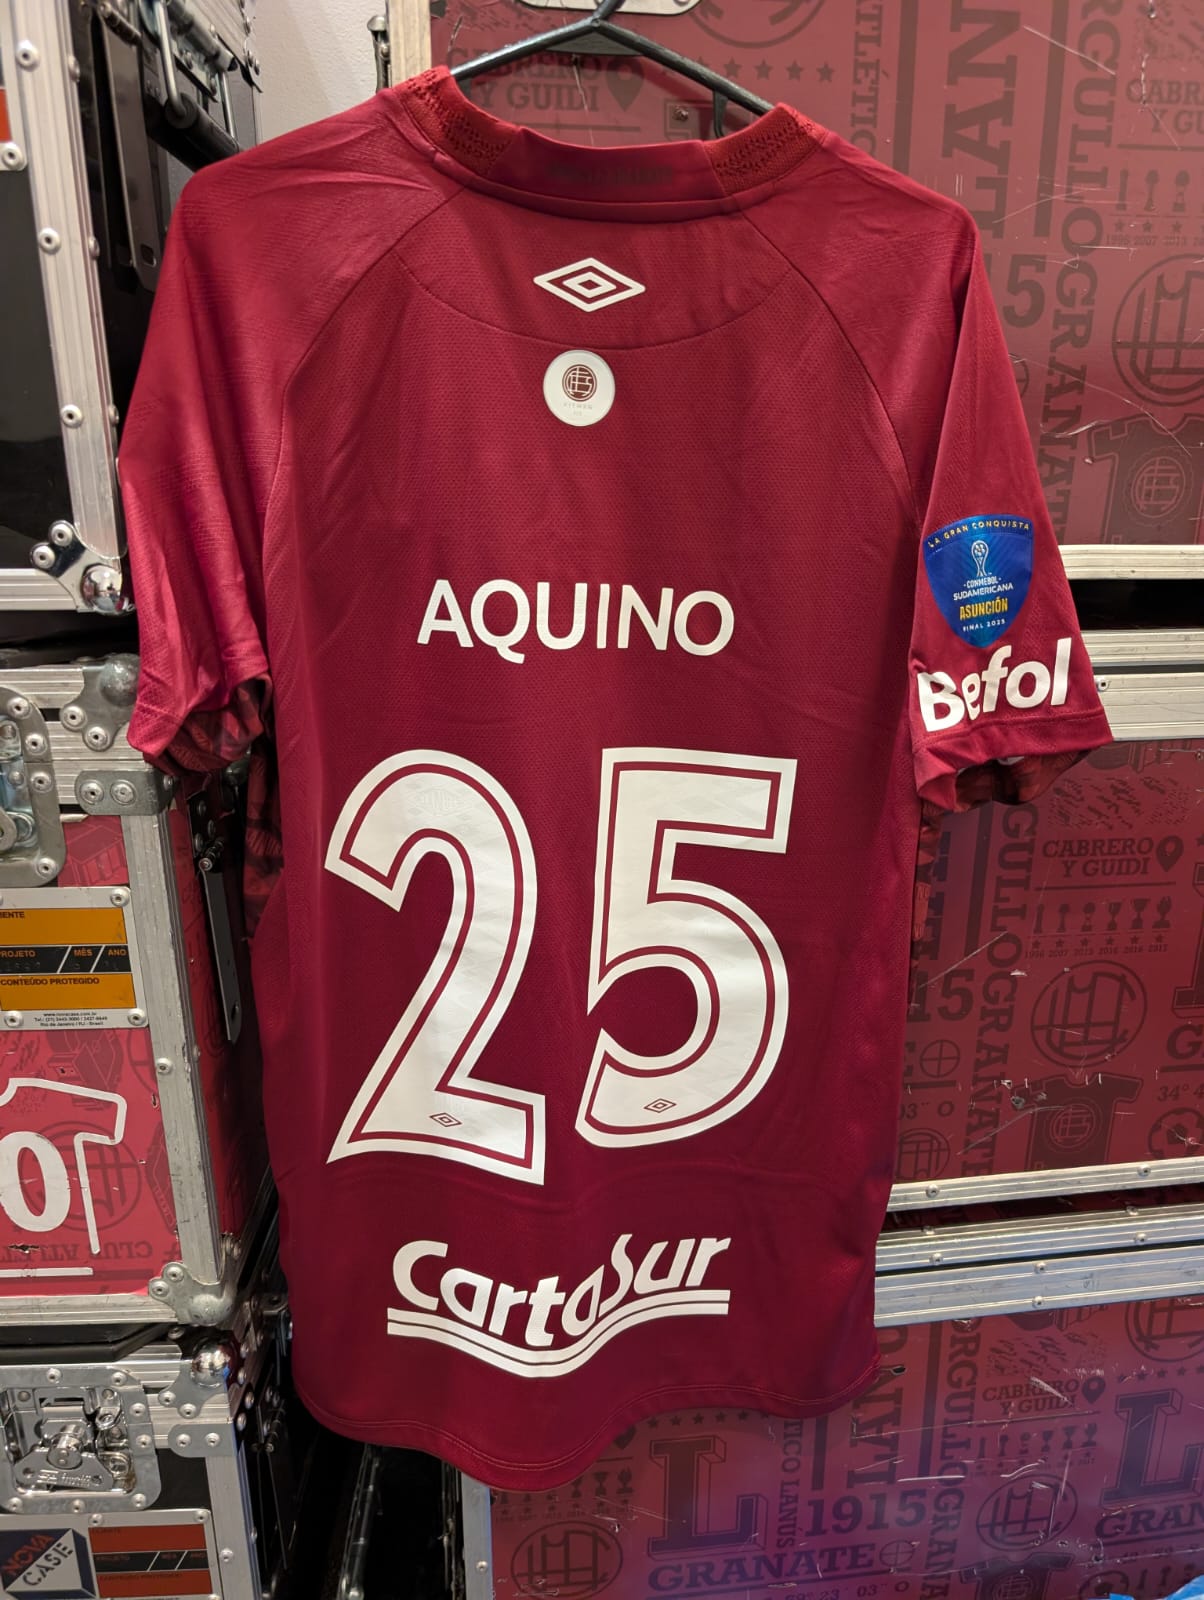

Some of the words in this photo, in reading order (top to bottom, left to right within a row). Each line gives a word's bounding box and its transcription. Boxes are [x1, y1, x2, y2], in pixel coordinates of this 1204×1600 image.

[507, 83, 600, 112] GUIDI
[851, 0, 888, 156] TLÉTIC
[1126, 80, 1204, 105] CABR
[942, 0, 1020, 239] LAN
[928, 537, 941, 548] LA
[944, 525, 969, 540] GRAN
[971, 519, 1031, 530] CONQUISTA
[953, 582, 1014, 601] SUDAMERICANA
[959, 596, 1009, 620] ASUNCIÓN
[416, 578, 736, 665] AQUINO
[962, 622, 984, 632] FINAL
[916, 637, 1072, 733] Befol
[1042, 837, 1154, 858] CABRERO
[1062, 859, 1078, 878] Y
[1082, 857, 1152, 877] GUIDI
[0, 949, 36, 958] ROJETO
[107, 948, 128, 957] ANO
[324, 746, 798, 1186] 25
[0, 976, 49, 986] CONTEÚDO
[50, 977, 100, 986] PROTEGIDO
[907, 968, 975, 1022] 15
[392, 1233, 732, 1348] CartaSur
[982, 1377, 1080, 1403] CABRERO
[780, 1419, 803, 1473] TICO
[776, 1479, 803, 1549] LANÚS
[804, 1488, 927, 1538] 1915
[1094, 1501, 1204, 1538] GRAN
[2, 1534, 55, 1576] NOVA
[23, 1542, 74, 1586] CASE
[648, 1542, 876, 1592] GRANATE
